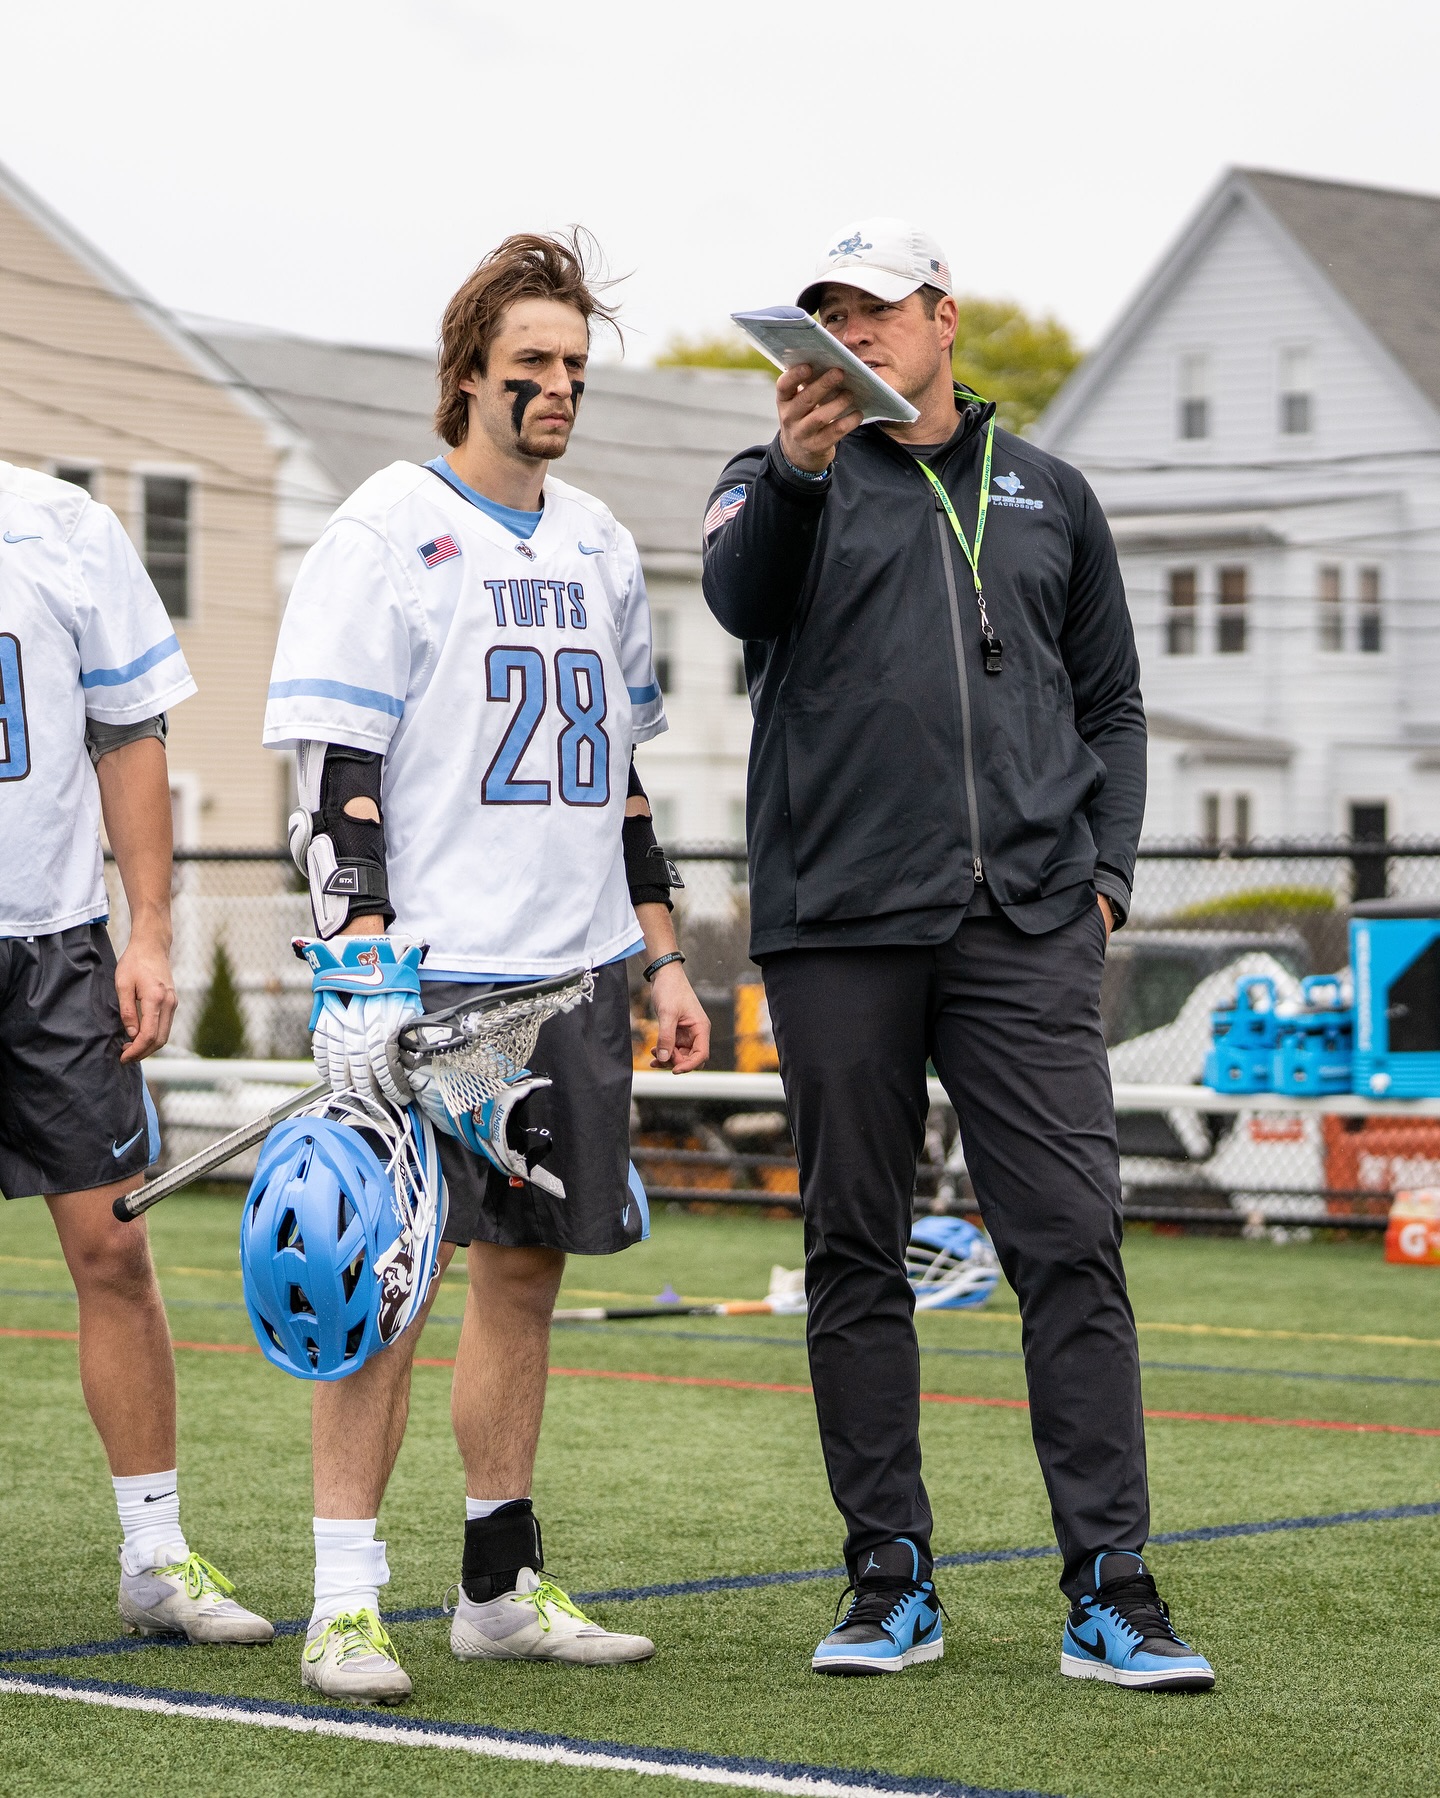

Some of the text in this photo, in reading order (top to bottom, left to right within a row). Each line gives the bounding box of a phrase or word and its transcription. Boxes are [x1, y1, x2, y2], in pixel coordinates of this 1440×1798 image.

[993, 501, 1034, 510] LACROSSE
[484, 579, 587, 629] TUFTS
[481, 645, 610, 807] 28
[305, 950, 321, 970] 28
[493, 1104, 504, 1142] JUMBOS
[1399, 1222, 1427, 1257] G
